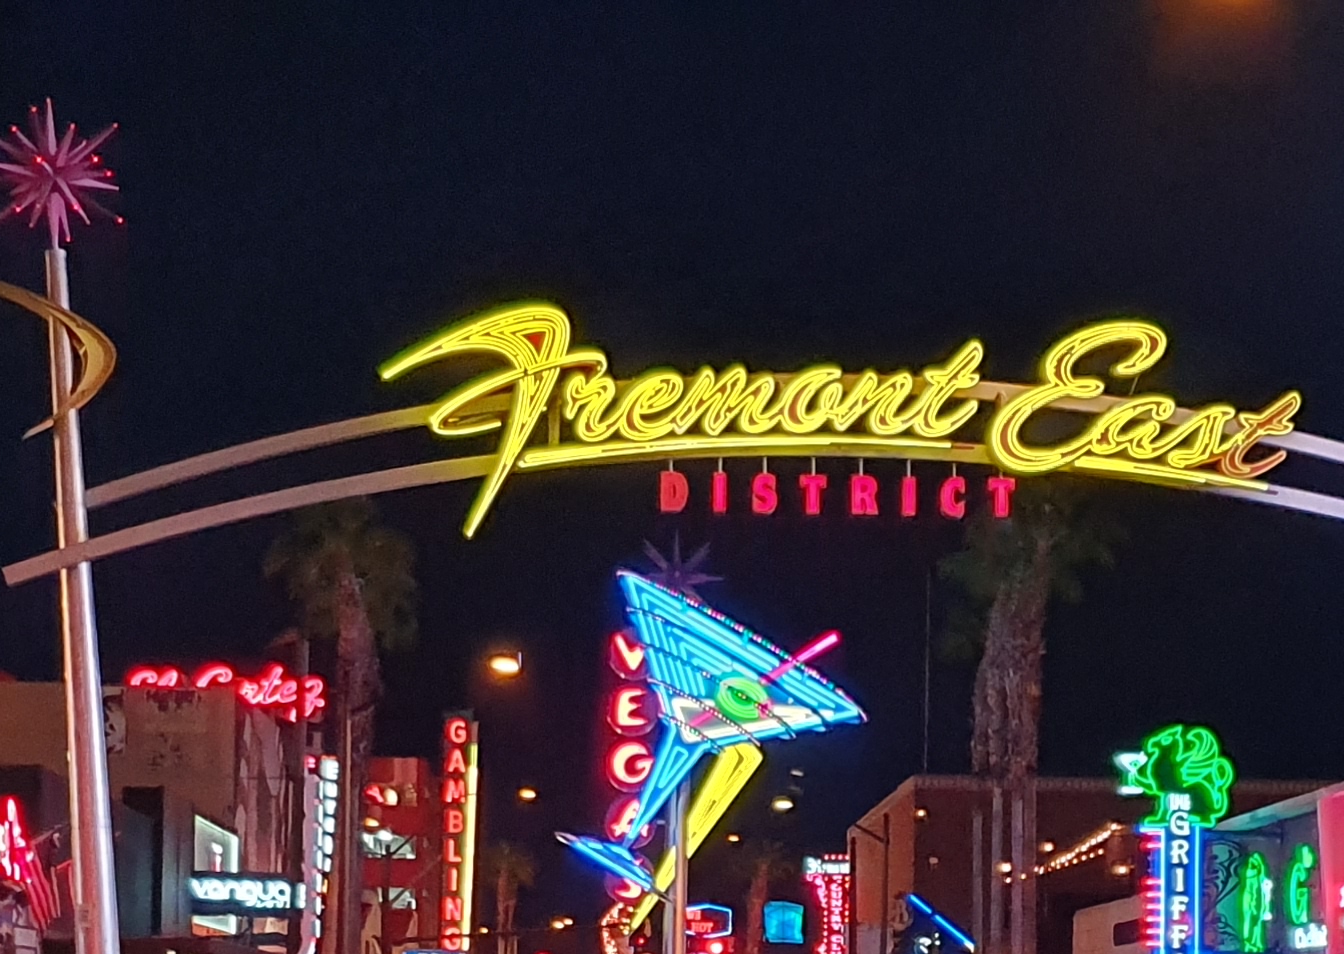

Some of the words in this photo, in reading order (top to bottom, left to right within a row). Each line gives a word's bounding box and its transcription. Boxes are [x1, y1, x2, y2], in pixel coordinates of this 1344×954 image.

[379, 304, 984, 539] Fremont
[989, 321, 1303, 476] East
[659, 470, 1017, 518] DISTRICT
[441, 719, 468, 952] GAMBLING
